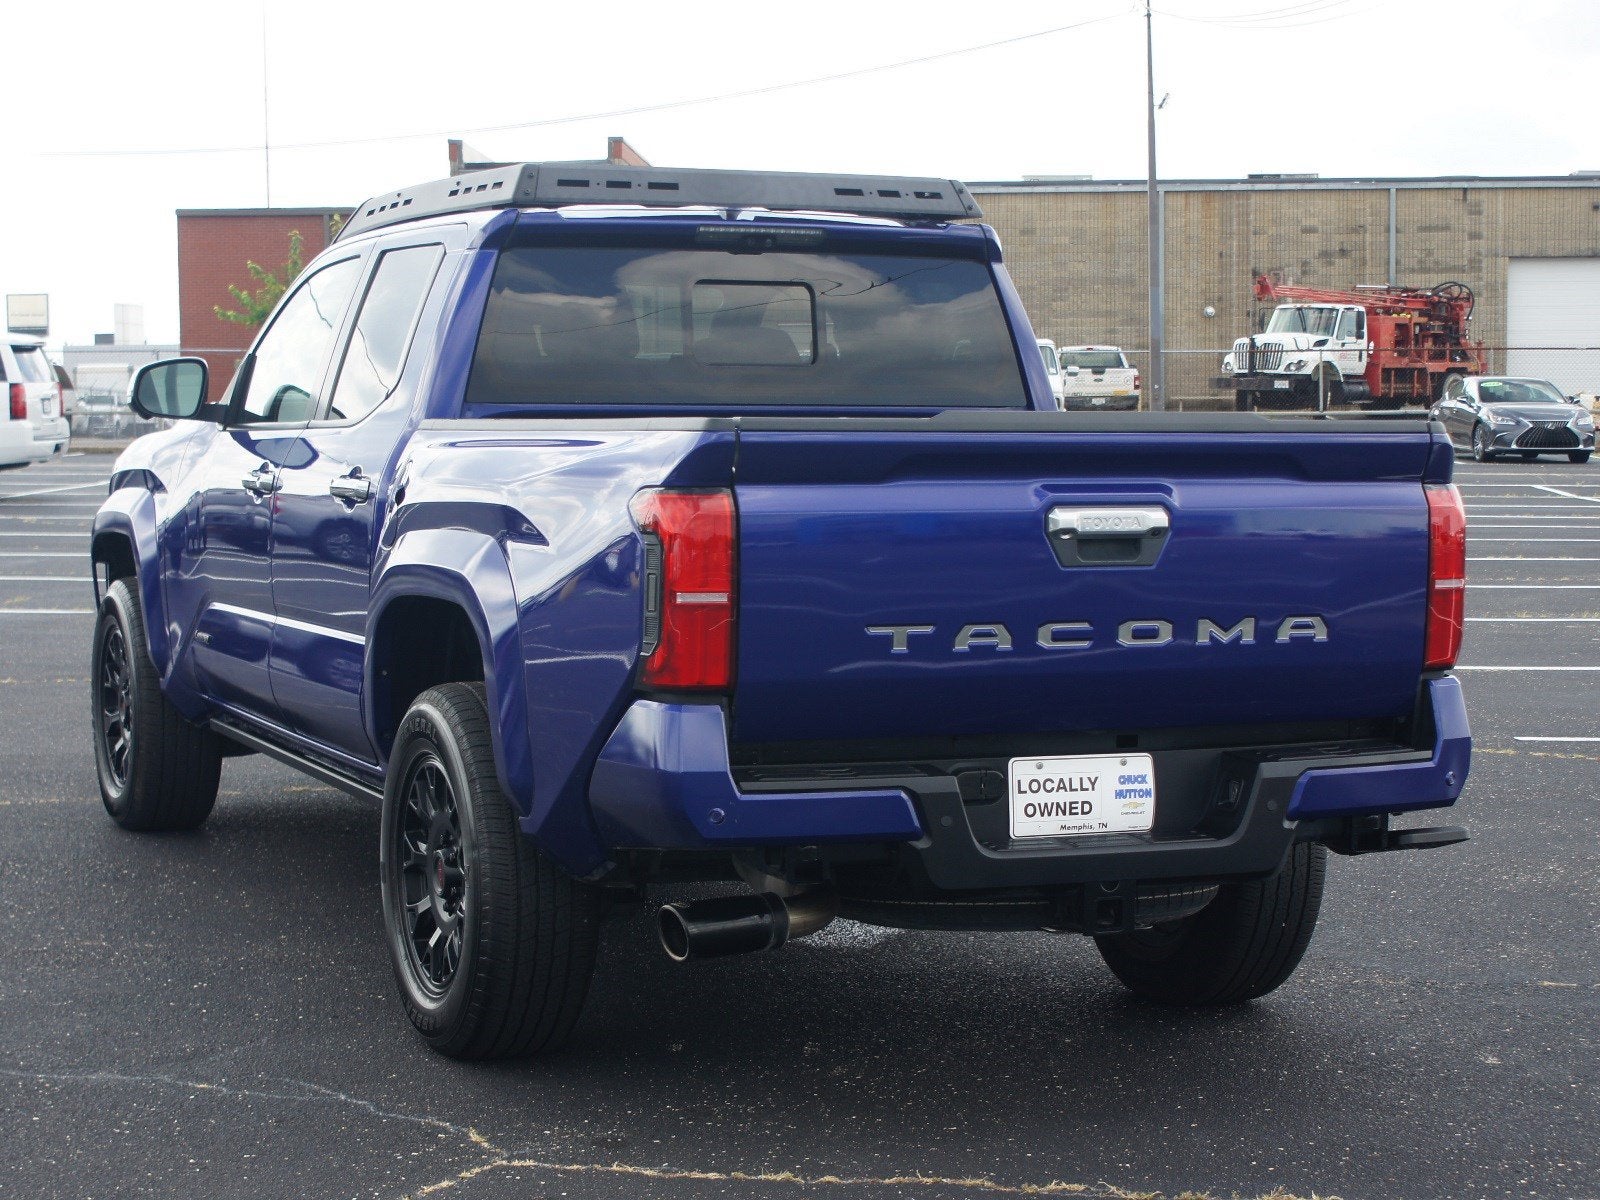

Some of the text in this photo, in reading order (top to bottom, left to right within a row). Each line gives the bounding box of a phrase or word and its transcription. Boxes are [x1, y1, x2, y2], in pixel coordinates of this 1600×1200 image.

[1081, 515, 1142, 529] TOYOTA
[864, 616, 1329, 653] TACOMA
[1017, 776, 1099, 794] LOCALLY
[1118, 774, 1148, 785] CHUCK
[1115, 788, 1152, 799] HUTTON
[1024, 801, 1093, 818] OWNED
[1059, 823, 1095, 831] Memphis,
